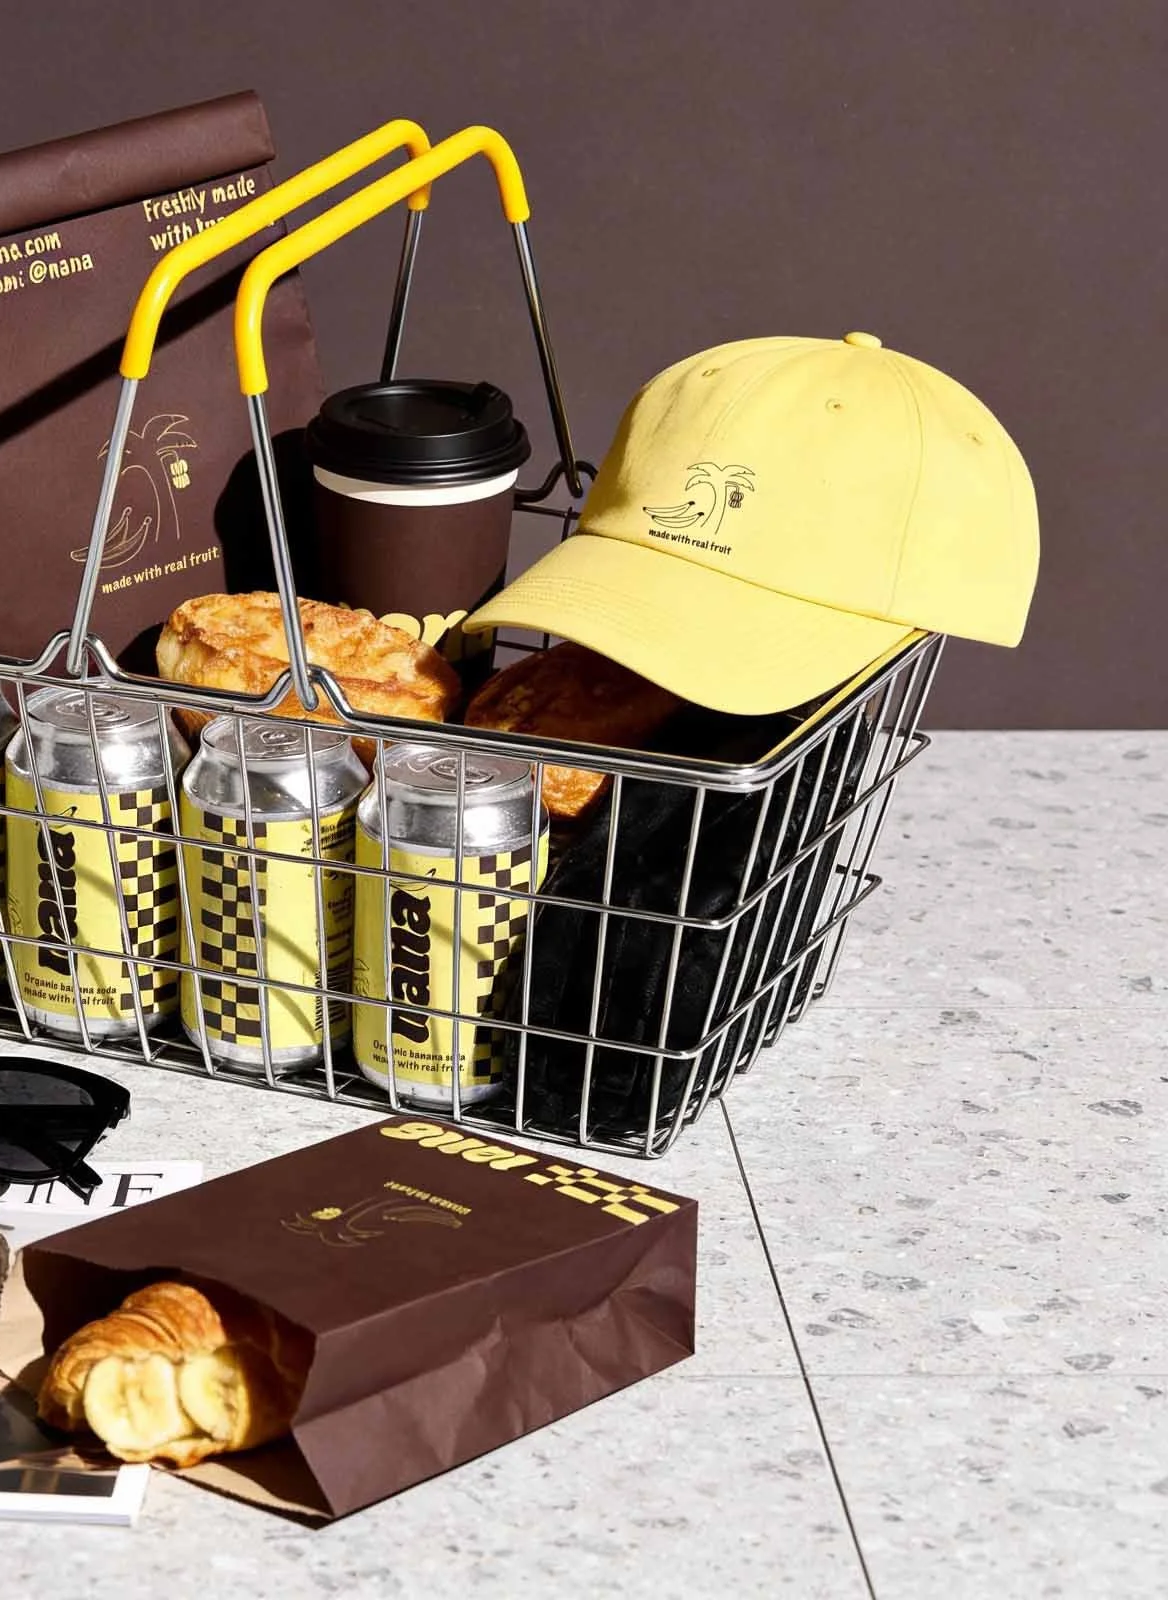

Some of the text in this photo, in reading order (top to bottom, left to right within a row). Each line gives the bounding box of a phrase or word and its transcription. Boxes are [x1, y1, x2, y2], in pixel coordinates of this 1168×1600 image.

[143, 176, 255, 222] Freshly made
[29, 254, 94, 284] @nana
[649, 528, 732, 555] made with real fruit
[102, 576, 132, 594] made
[134, 564, 162, 584] with
[164, 555, 187, 575] real
[38, 828, 79, 977] nana
[390, 889, 431, 1044] nana
[24, 972, 58, 990] Organic
[96, 985, 117, 995] soda
[24, 986, 46, 999] made
[48, 993, 71, 1005] with
[398, 1060, 420, 1072] with
[421, 1064, 439, 1073] real
[409, 1049, 443, 1062] banana
